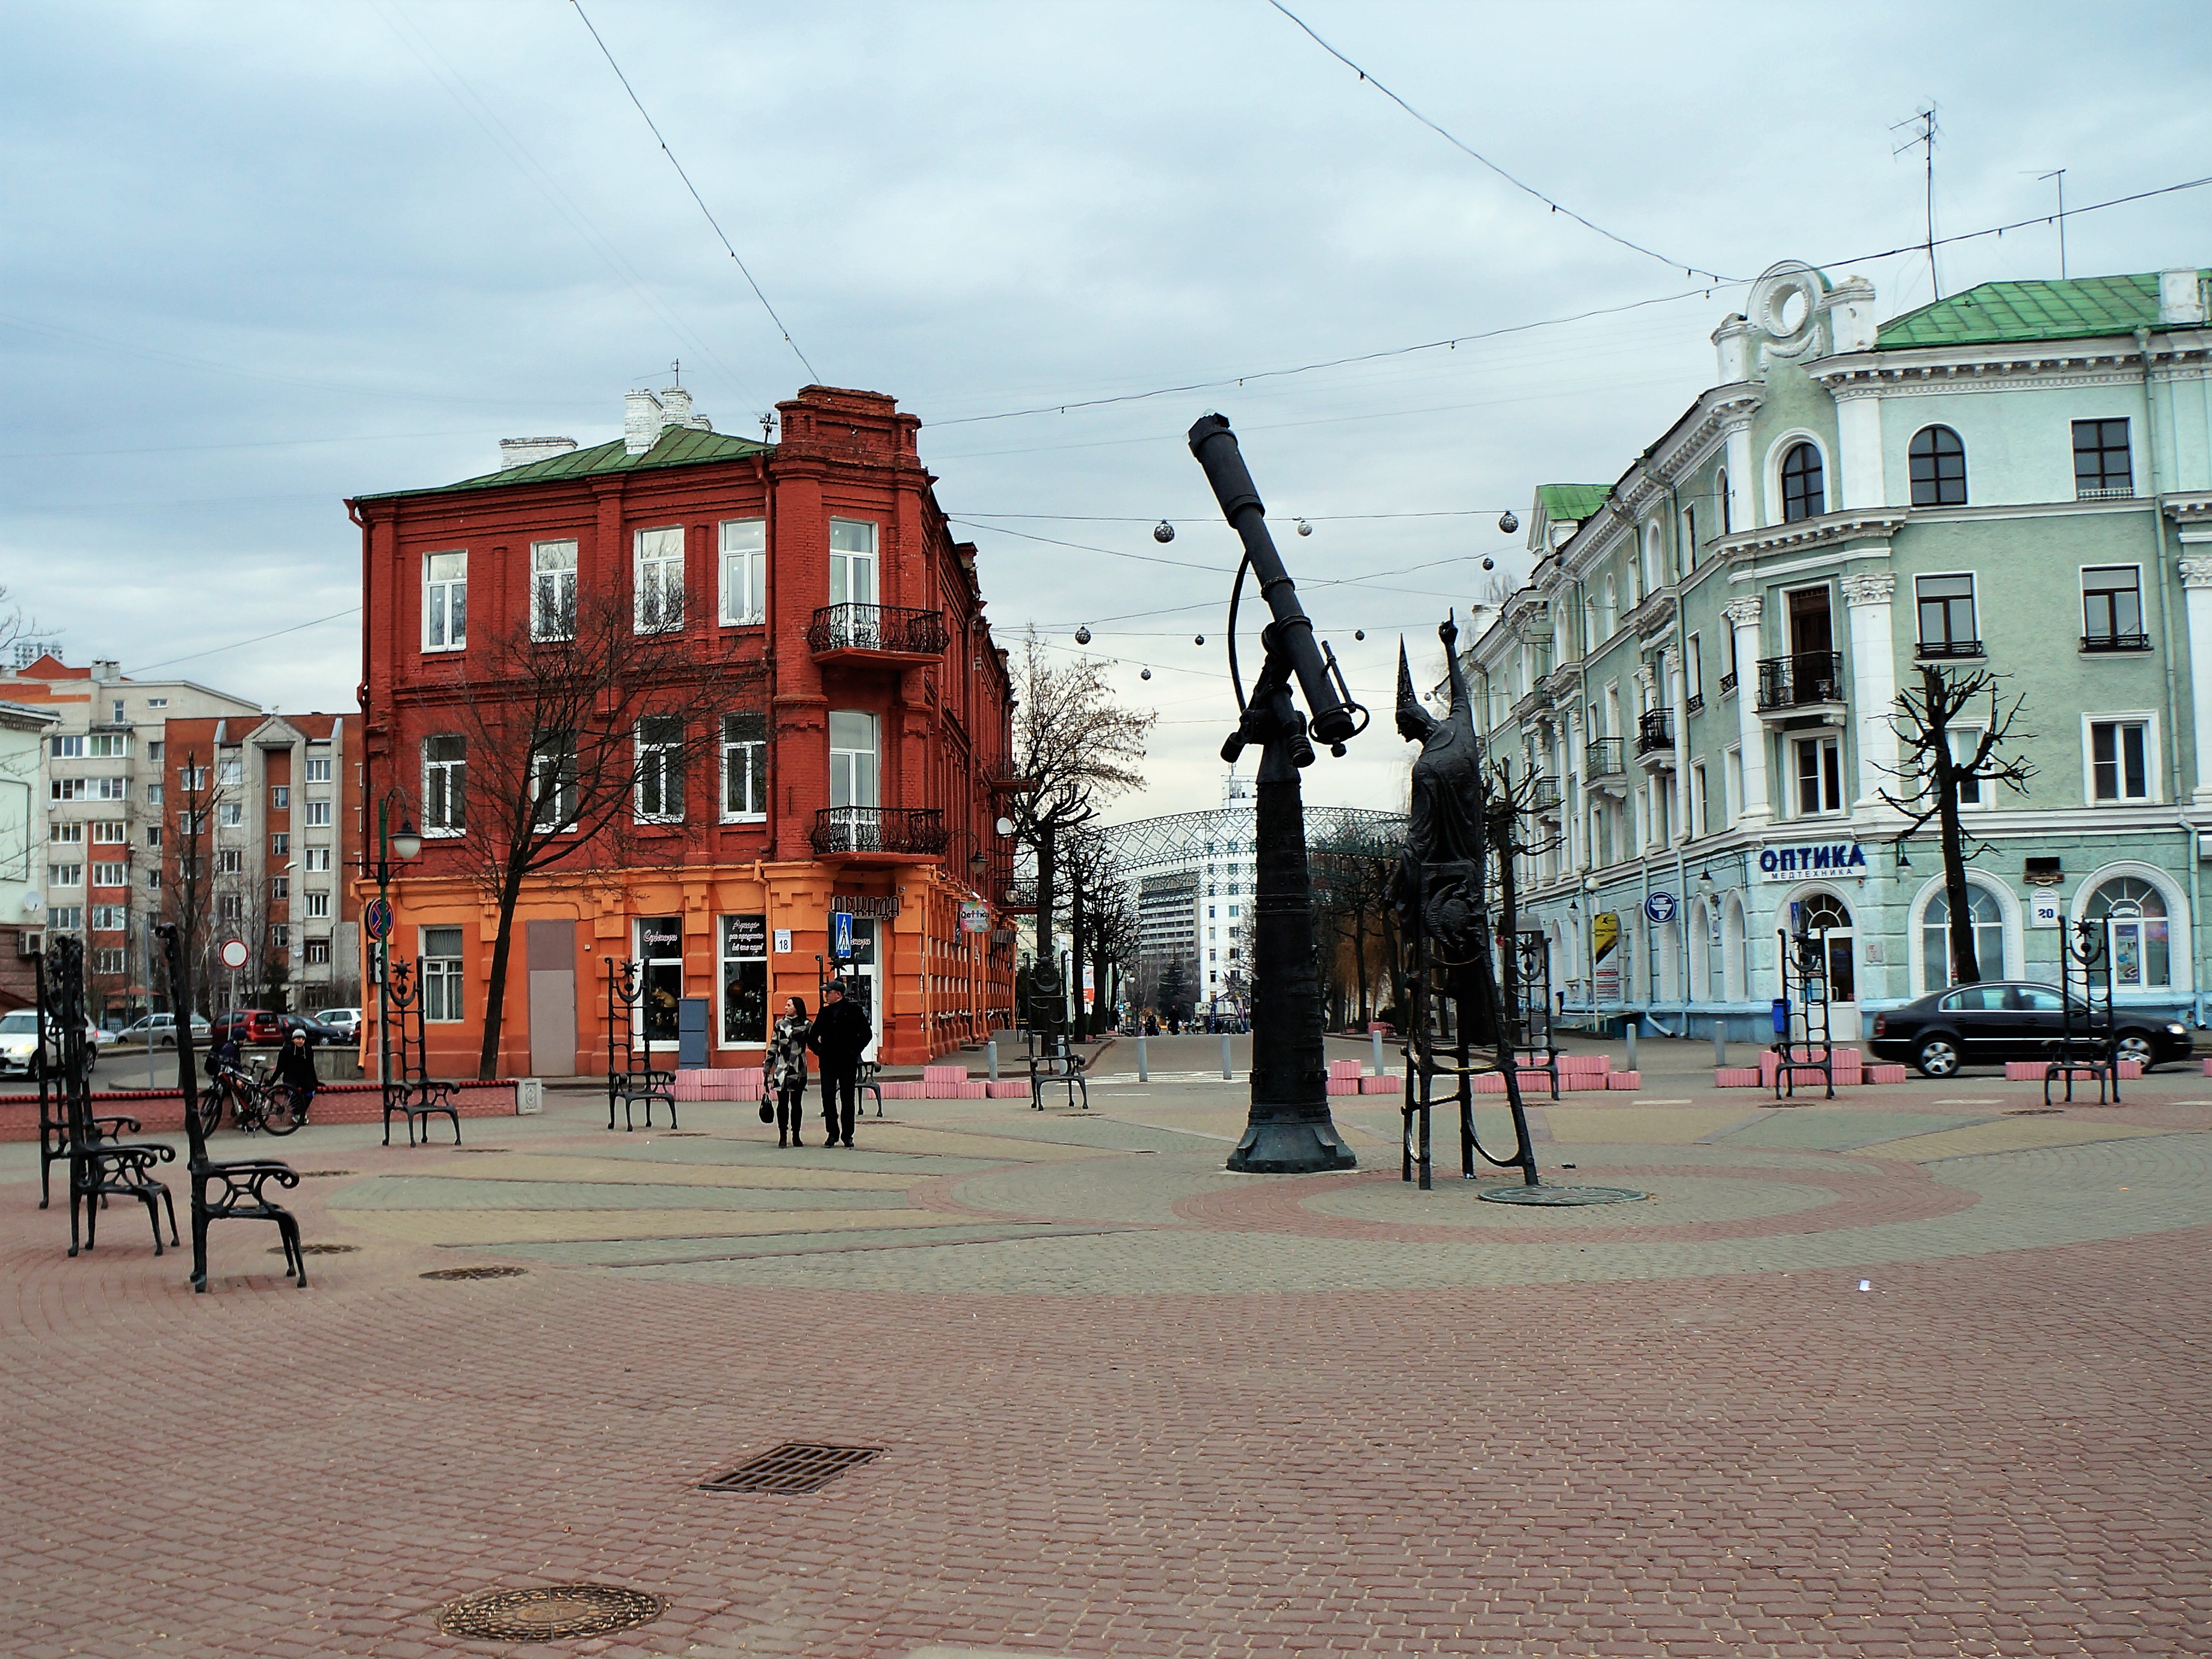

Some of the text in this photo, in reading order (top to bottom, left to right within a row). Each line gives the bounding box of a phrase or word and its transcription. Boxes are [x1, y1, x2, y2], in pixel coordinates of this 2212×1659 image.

[1760, 845, 1866, 872] ОПТИКА
[1772, 868, 1853, 879] МЕДТЕХНИКА
[830, 895, 901, 920] АРКАДА
[2038, 908, 2054, 919] 20
[643, 929, 678, 946] Сувениры
[779, 939, 788, 950] 18
